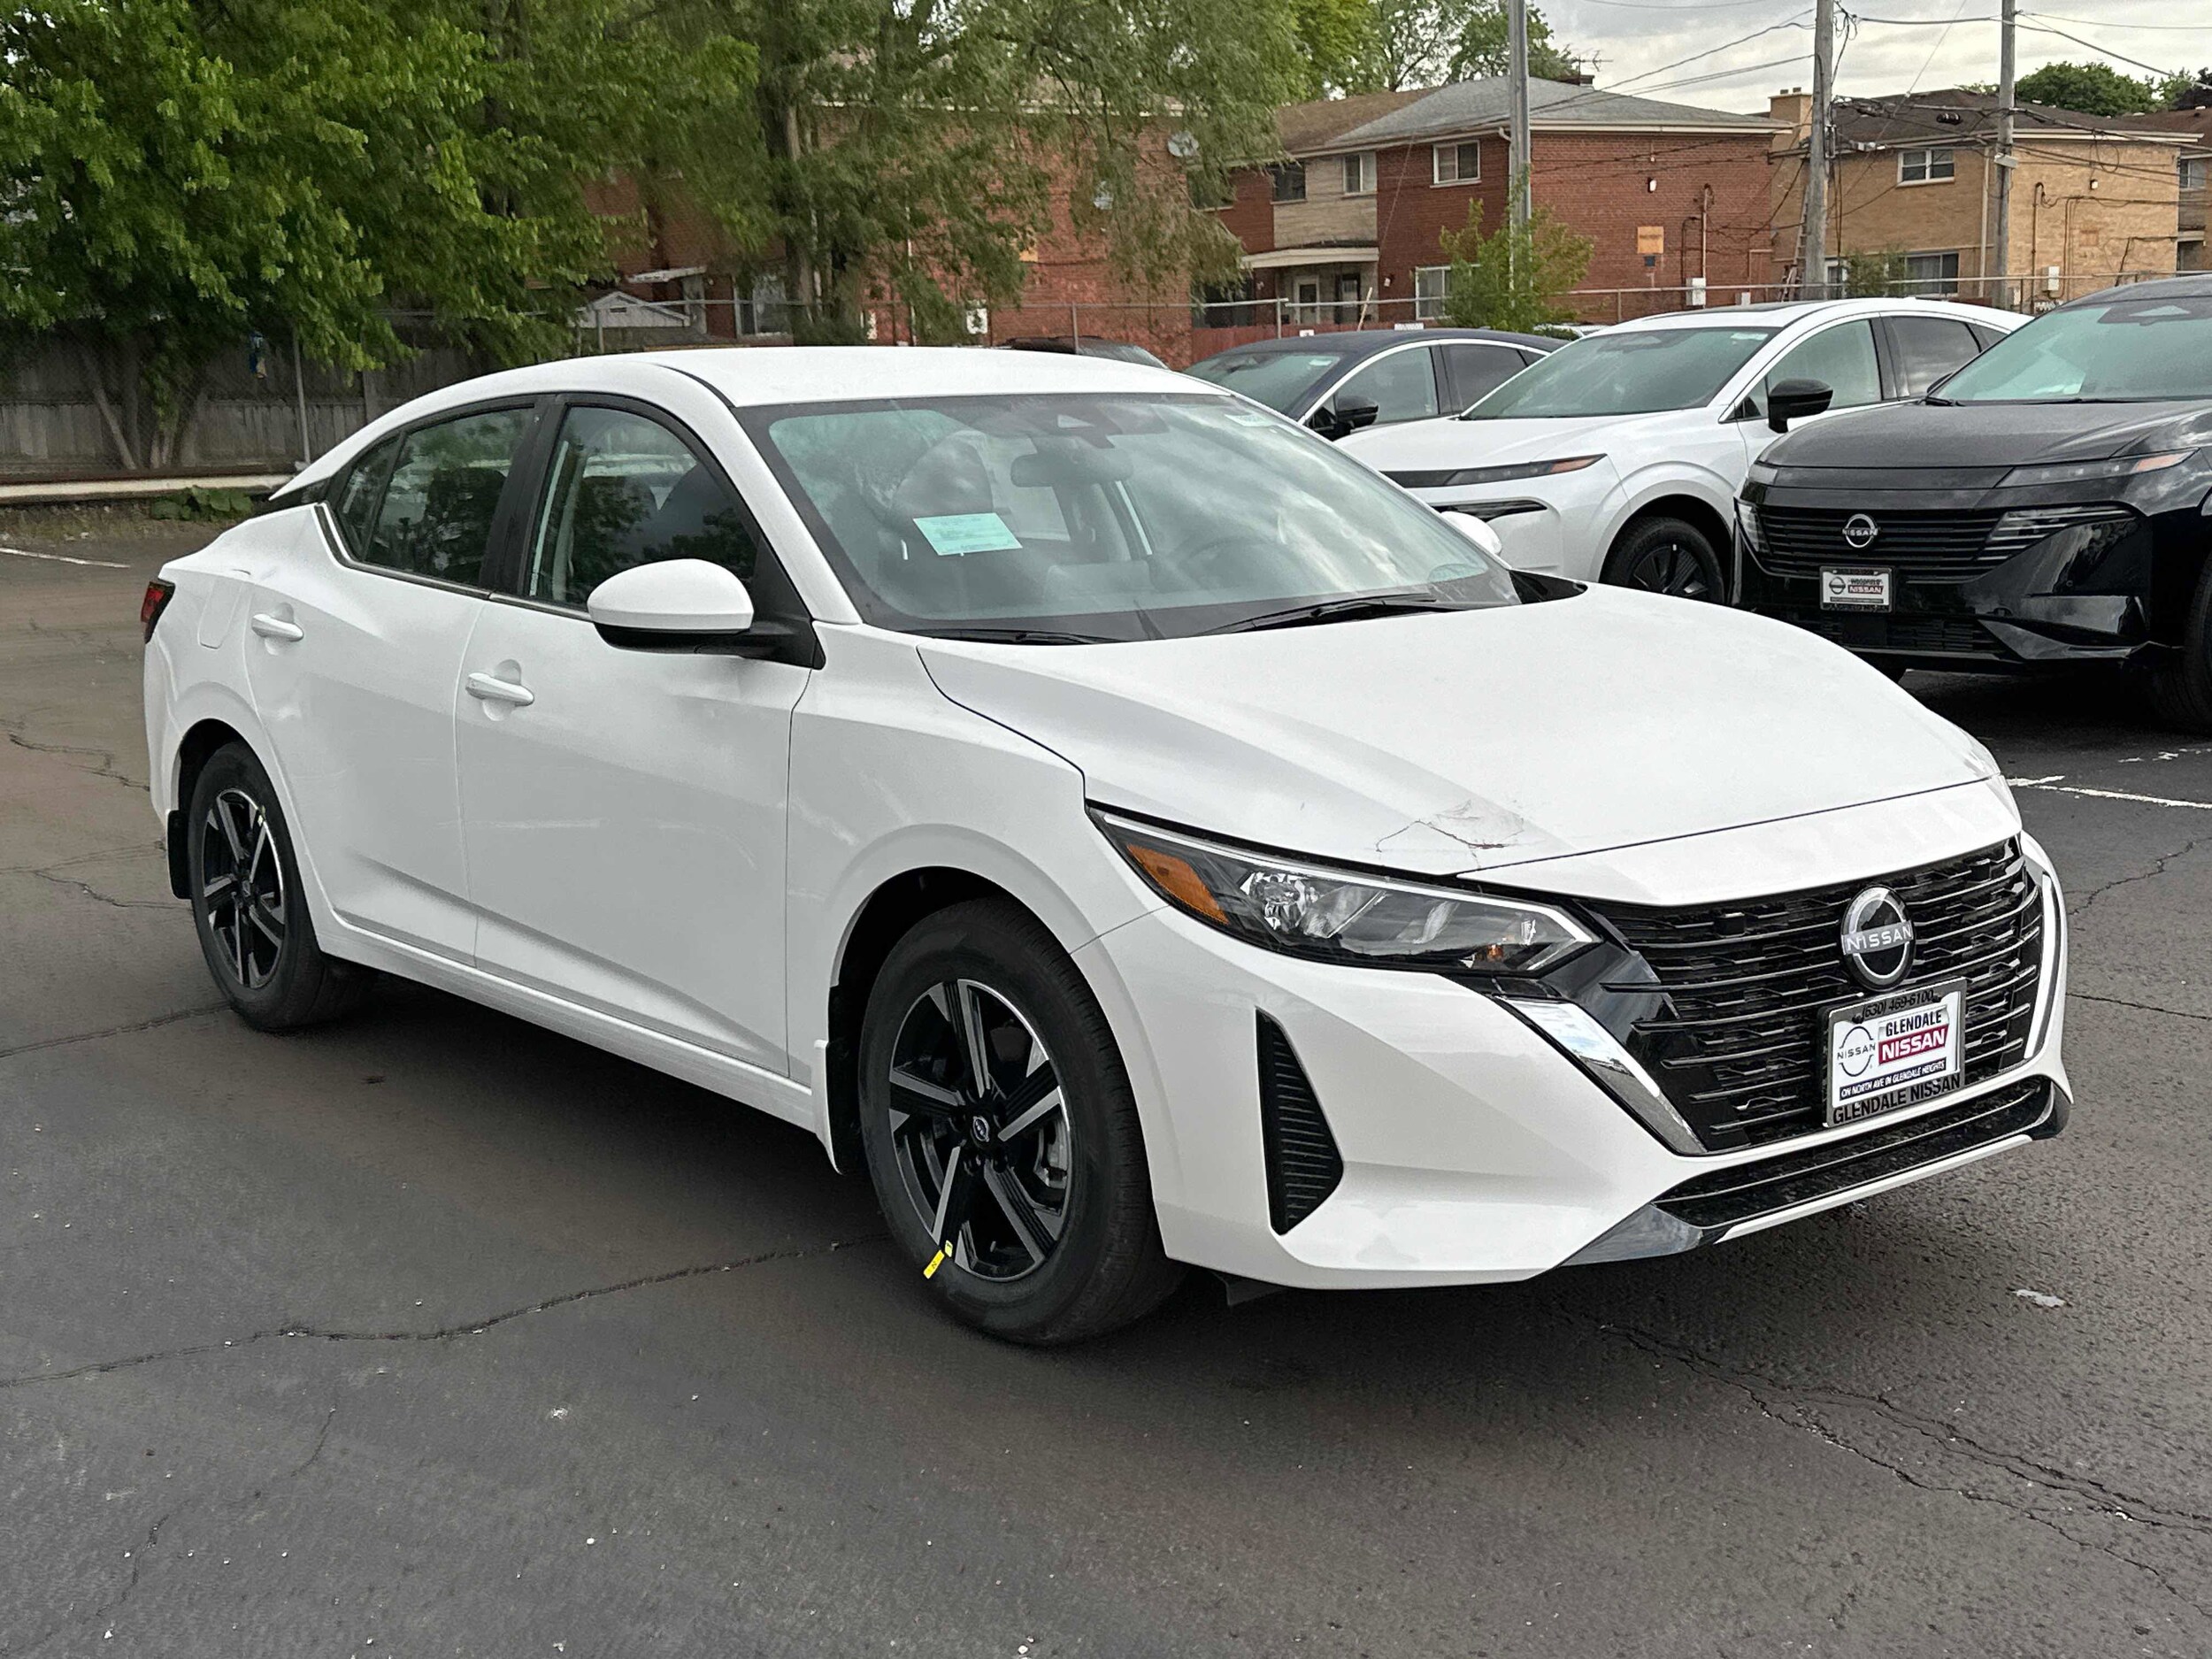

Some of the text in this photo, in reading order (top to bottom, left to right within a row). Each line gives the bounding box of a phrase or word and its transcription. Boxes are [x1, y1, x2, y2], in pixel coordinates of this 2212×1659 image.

[1842, 527, 1878, 536] NISSAN
[1846, 924, 1912, 951] NISSAN
[1863, 988, 1934, 1019] (630) 469-6100
[1886, 1009, 1942, 1037] GLENDALE
[1837, 1043, 1876, 1060] NISSAN
[1882, 1028, 1946, 1061] NISSAN
[1840, 1088, 1852, 1098] ON
[1851, 1079, 1872, 1094] NORTH
[1892, 1066, 1922, 1082] GLENDALE
[1832, 1073, 1961, 1125] GLENDALE NISSAN
